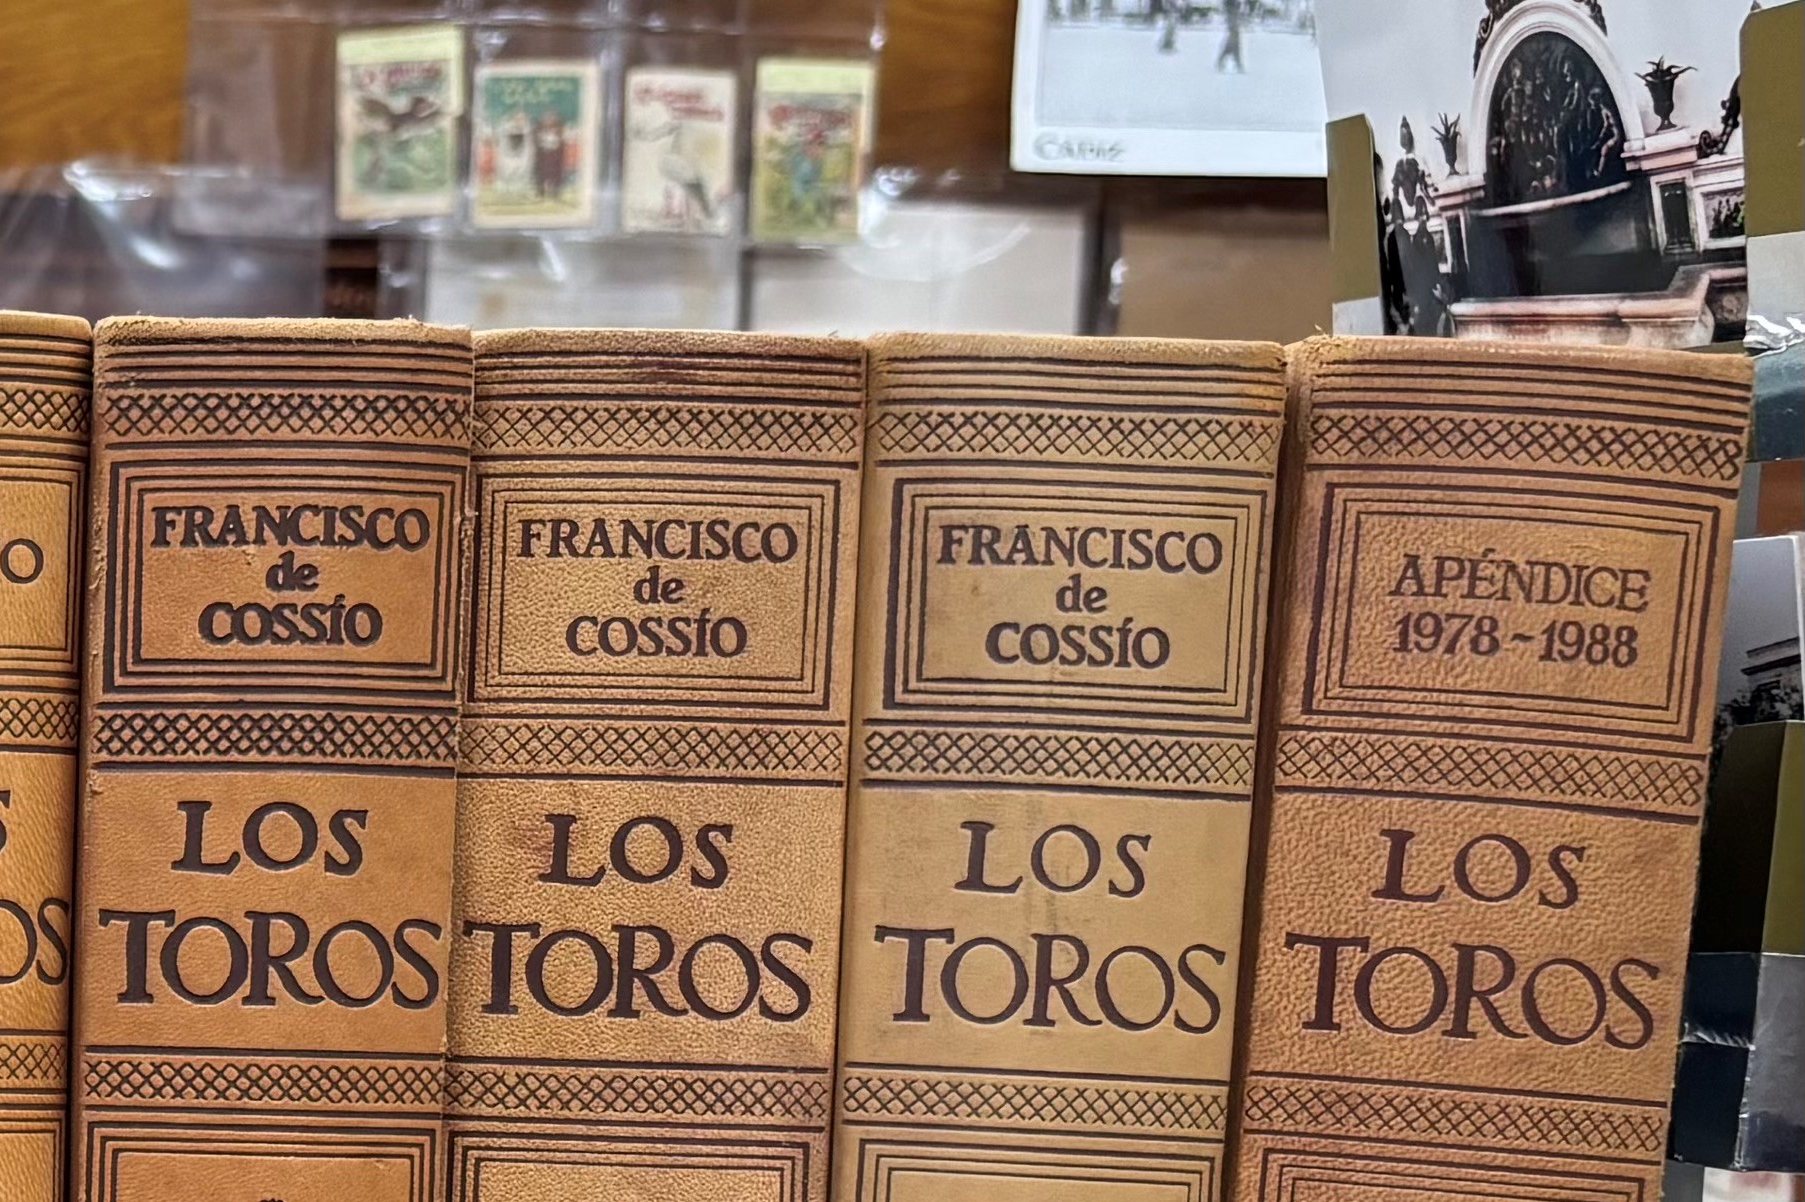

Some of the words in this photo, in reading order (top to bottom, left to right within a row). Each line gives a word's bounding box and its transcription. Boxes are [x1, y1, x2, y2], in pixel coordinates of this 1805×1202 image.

[151, 504, 431, 553] FRANCISCO
[517, 518, 799, 565] FRANCISCO
[937, 524, 1222, 575] FRANCISCO
[265, 552, 319, 591] de
[634, 566, 684, 604] de
[1056, 576, 1108, 615] de
[1390, 547, 1651, 614] APÉNDICE
[198, 592, 383, 648] COSSÍO
[565, 607, 748, 659] COSSÍO
[985, 617, 1170, 671] COSSÍO
[171, 800, 368, 876] LOS
[538, 814, 733, 889] LOS
[954, 822, 1152, 899] LOS
[1371, 828, 1586, 911] LOS
[99, 910, 442, 1010] TOROS
[463, 921, 812, 1023] TOROS
[874, 925, 1227, 1035] TOROS
[1285, 932, 1661, 1050] TOROS
